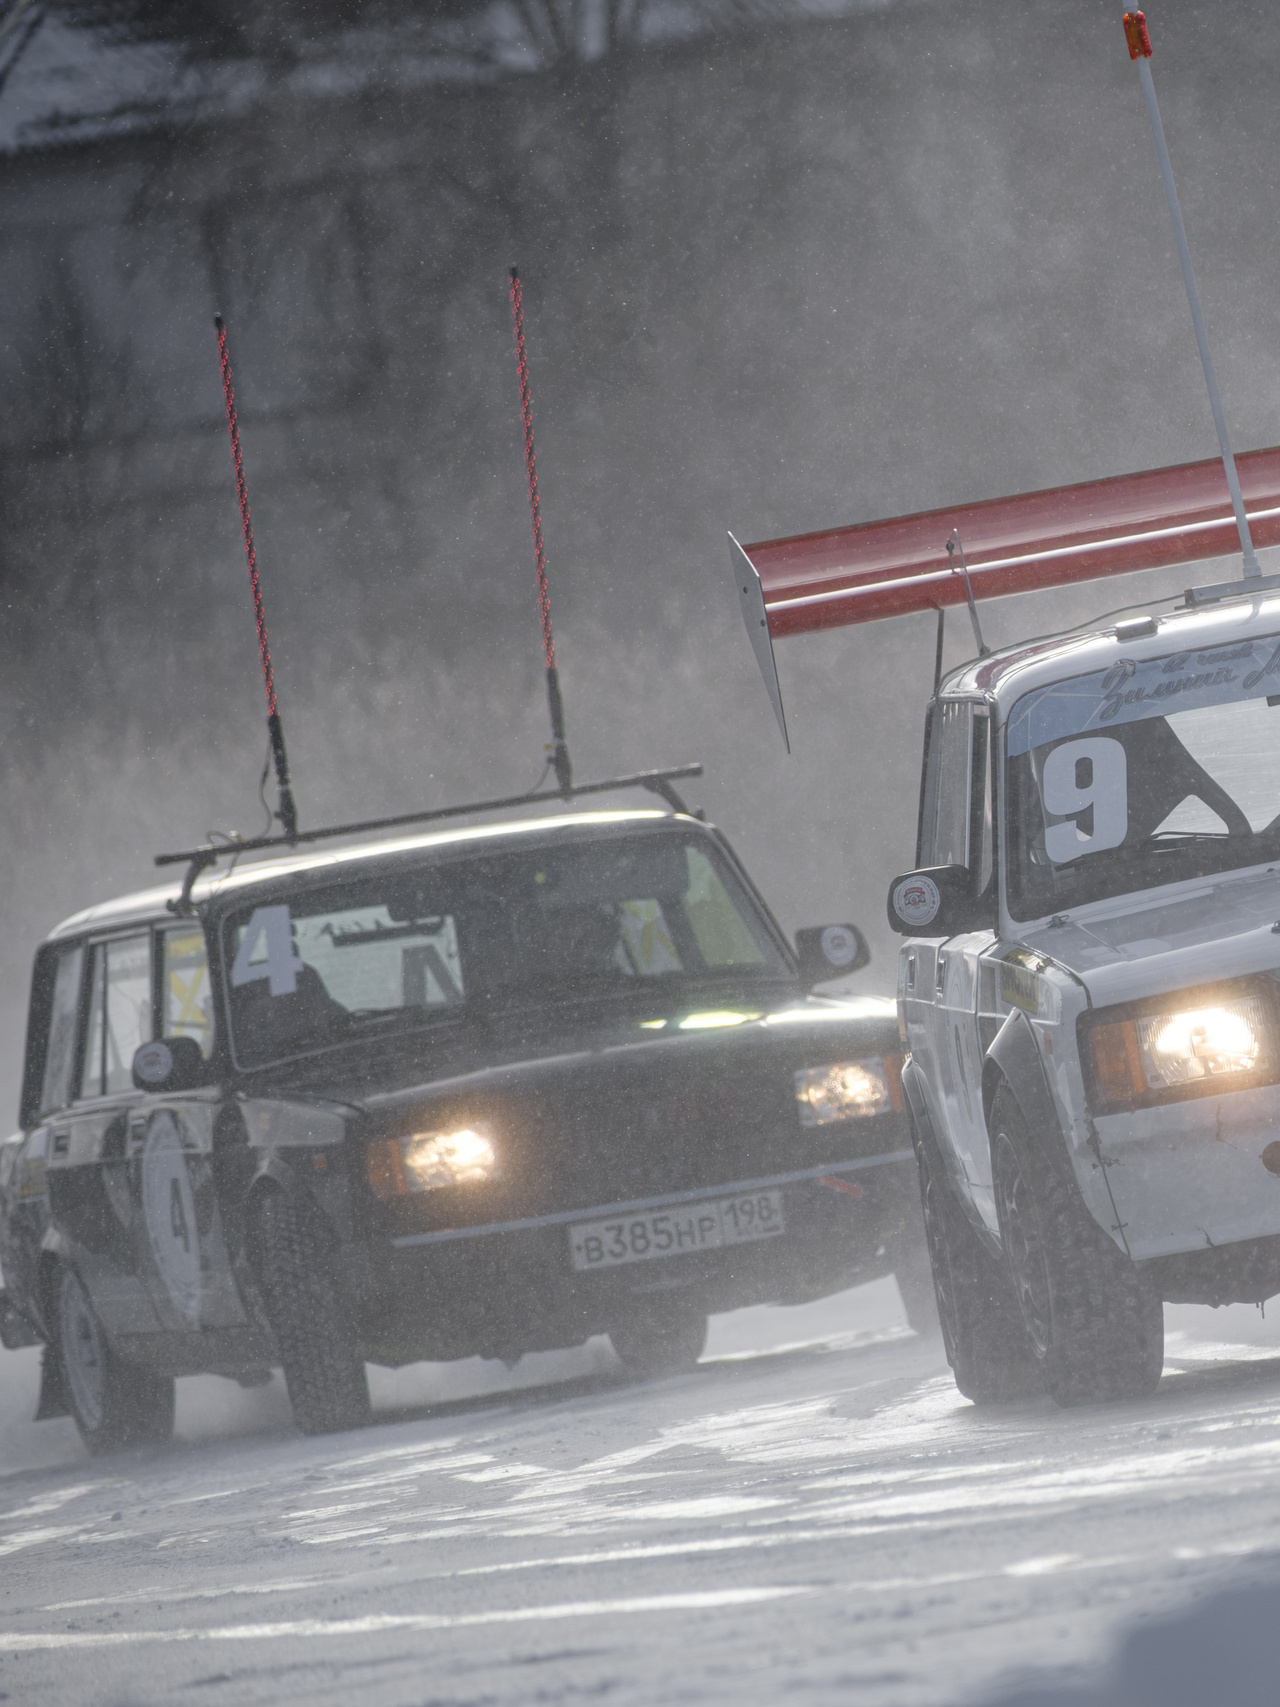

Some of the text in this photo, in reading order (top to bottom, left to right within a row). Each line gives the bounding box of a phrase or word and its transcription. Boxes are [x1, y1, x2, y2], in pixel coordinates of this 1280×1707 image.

[1100, 663, 1238, 721] Зимний
[1042, 737, 1127, 863] 9
[232, 904, 302, 998] 4
[724, 1196, 775, 1228] 198
